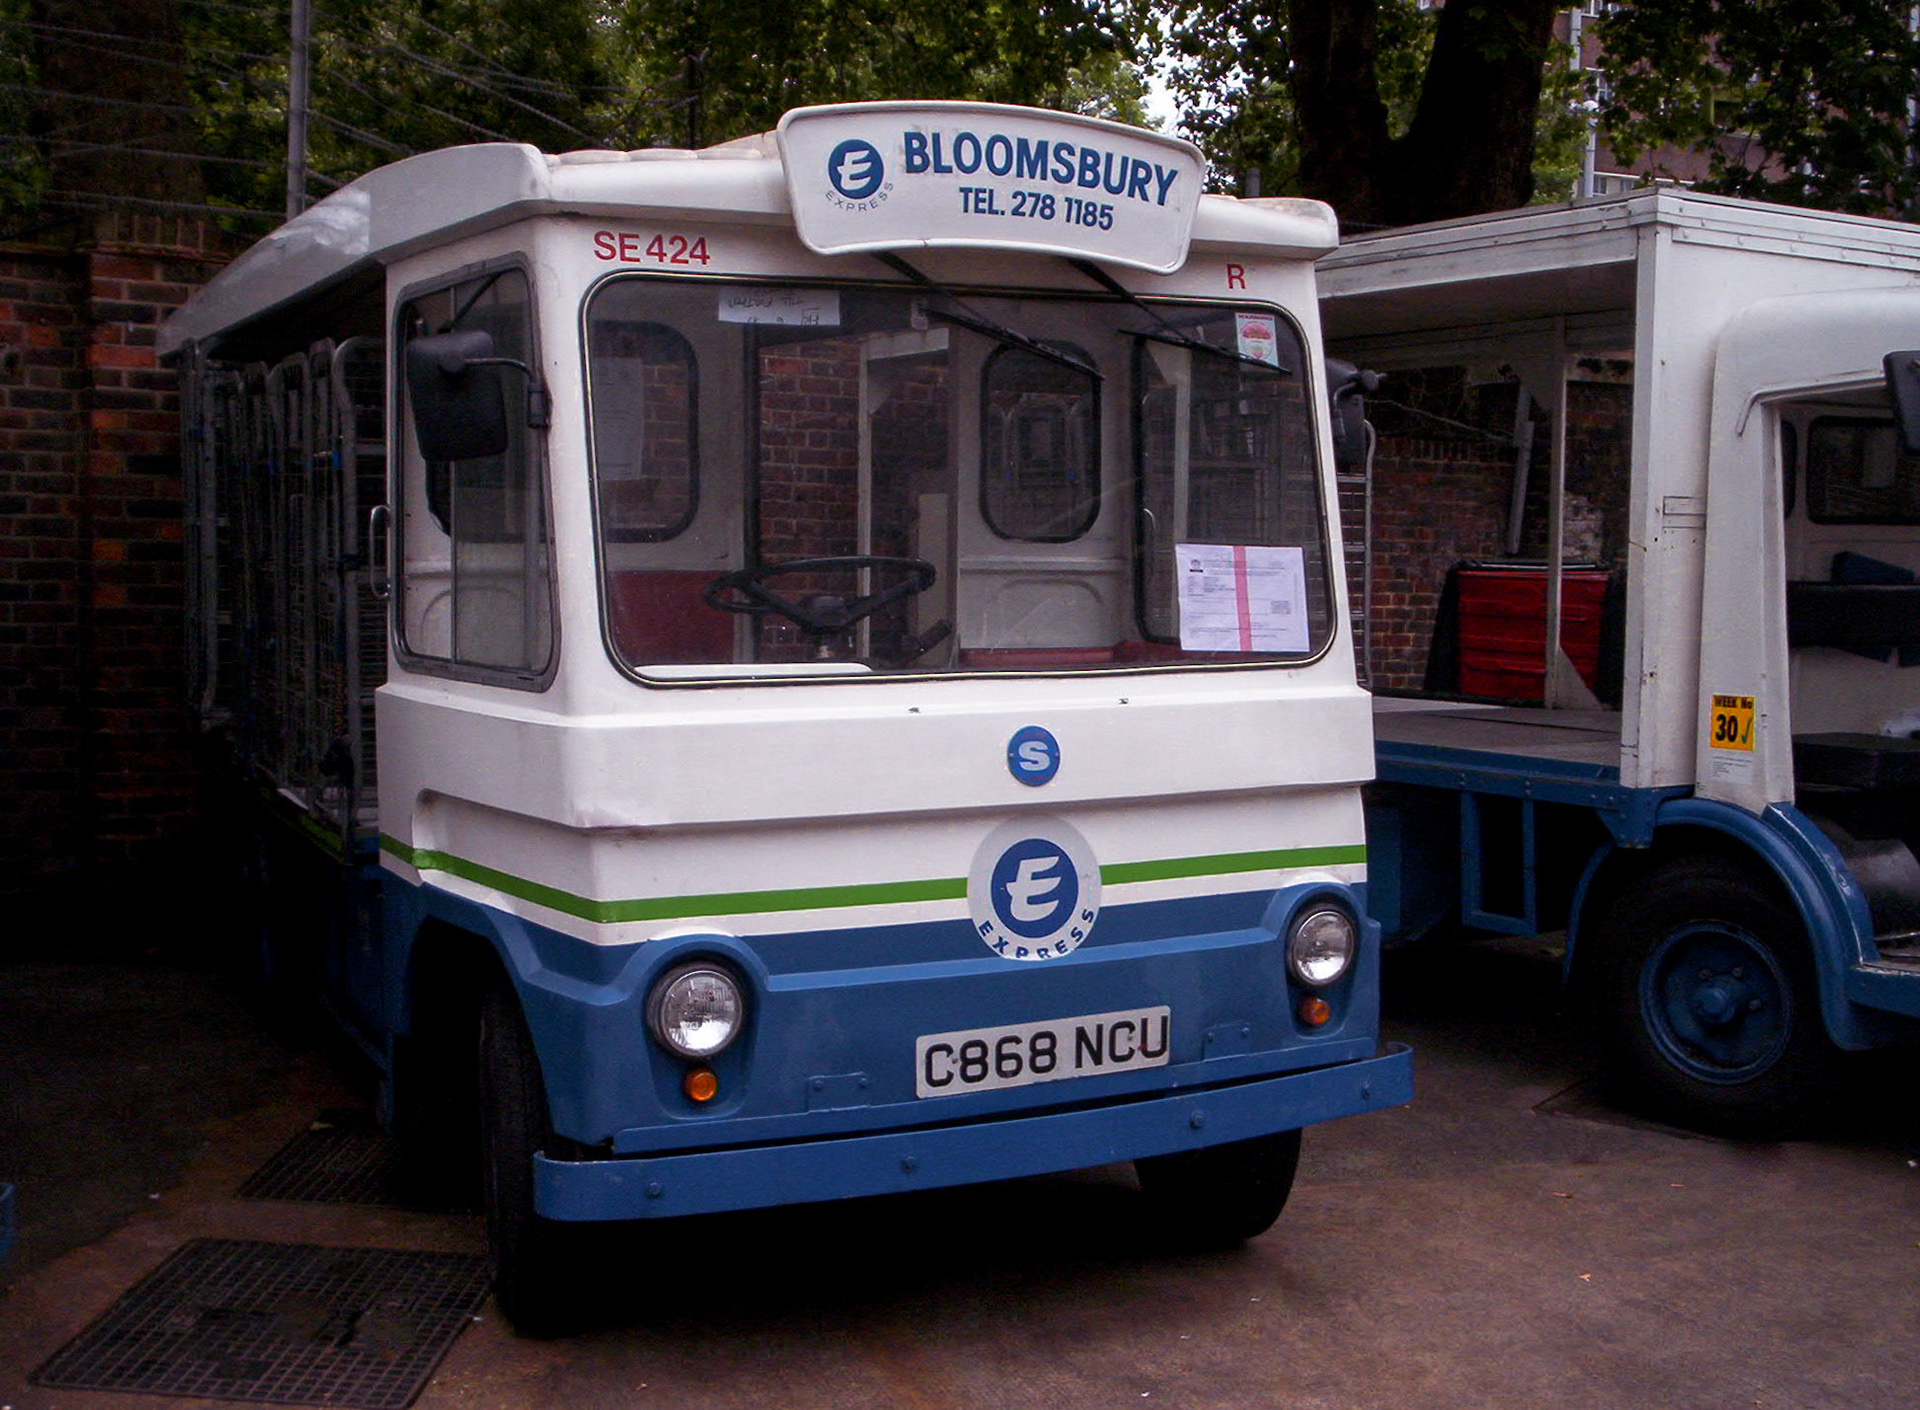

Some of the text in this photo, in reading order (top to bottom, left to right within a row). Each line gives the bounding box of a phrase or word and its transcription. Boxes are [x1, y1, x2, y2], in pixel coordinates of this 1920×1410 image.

[903, 131, 1179, 207] BLOOMSBURY
[825, 182, 894, 213] EXPRESS
[959, 186, 1115, 231] TEL. 278 1185
[1225, 263, 1246, 290] R
[1715, 713, 1738, 742] 30
[1018, 740, 1051, 772] S
[978, 907, 1095, 960] EXPRESS
[924, 1015, 1169, 1088] C868 NCU
